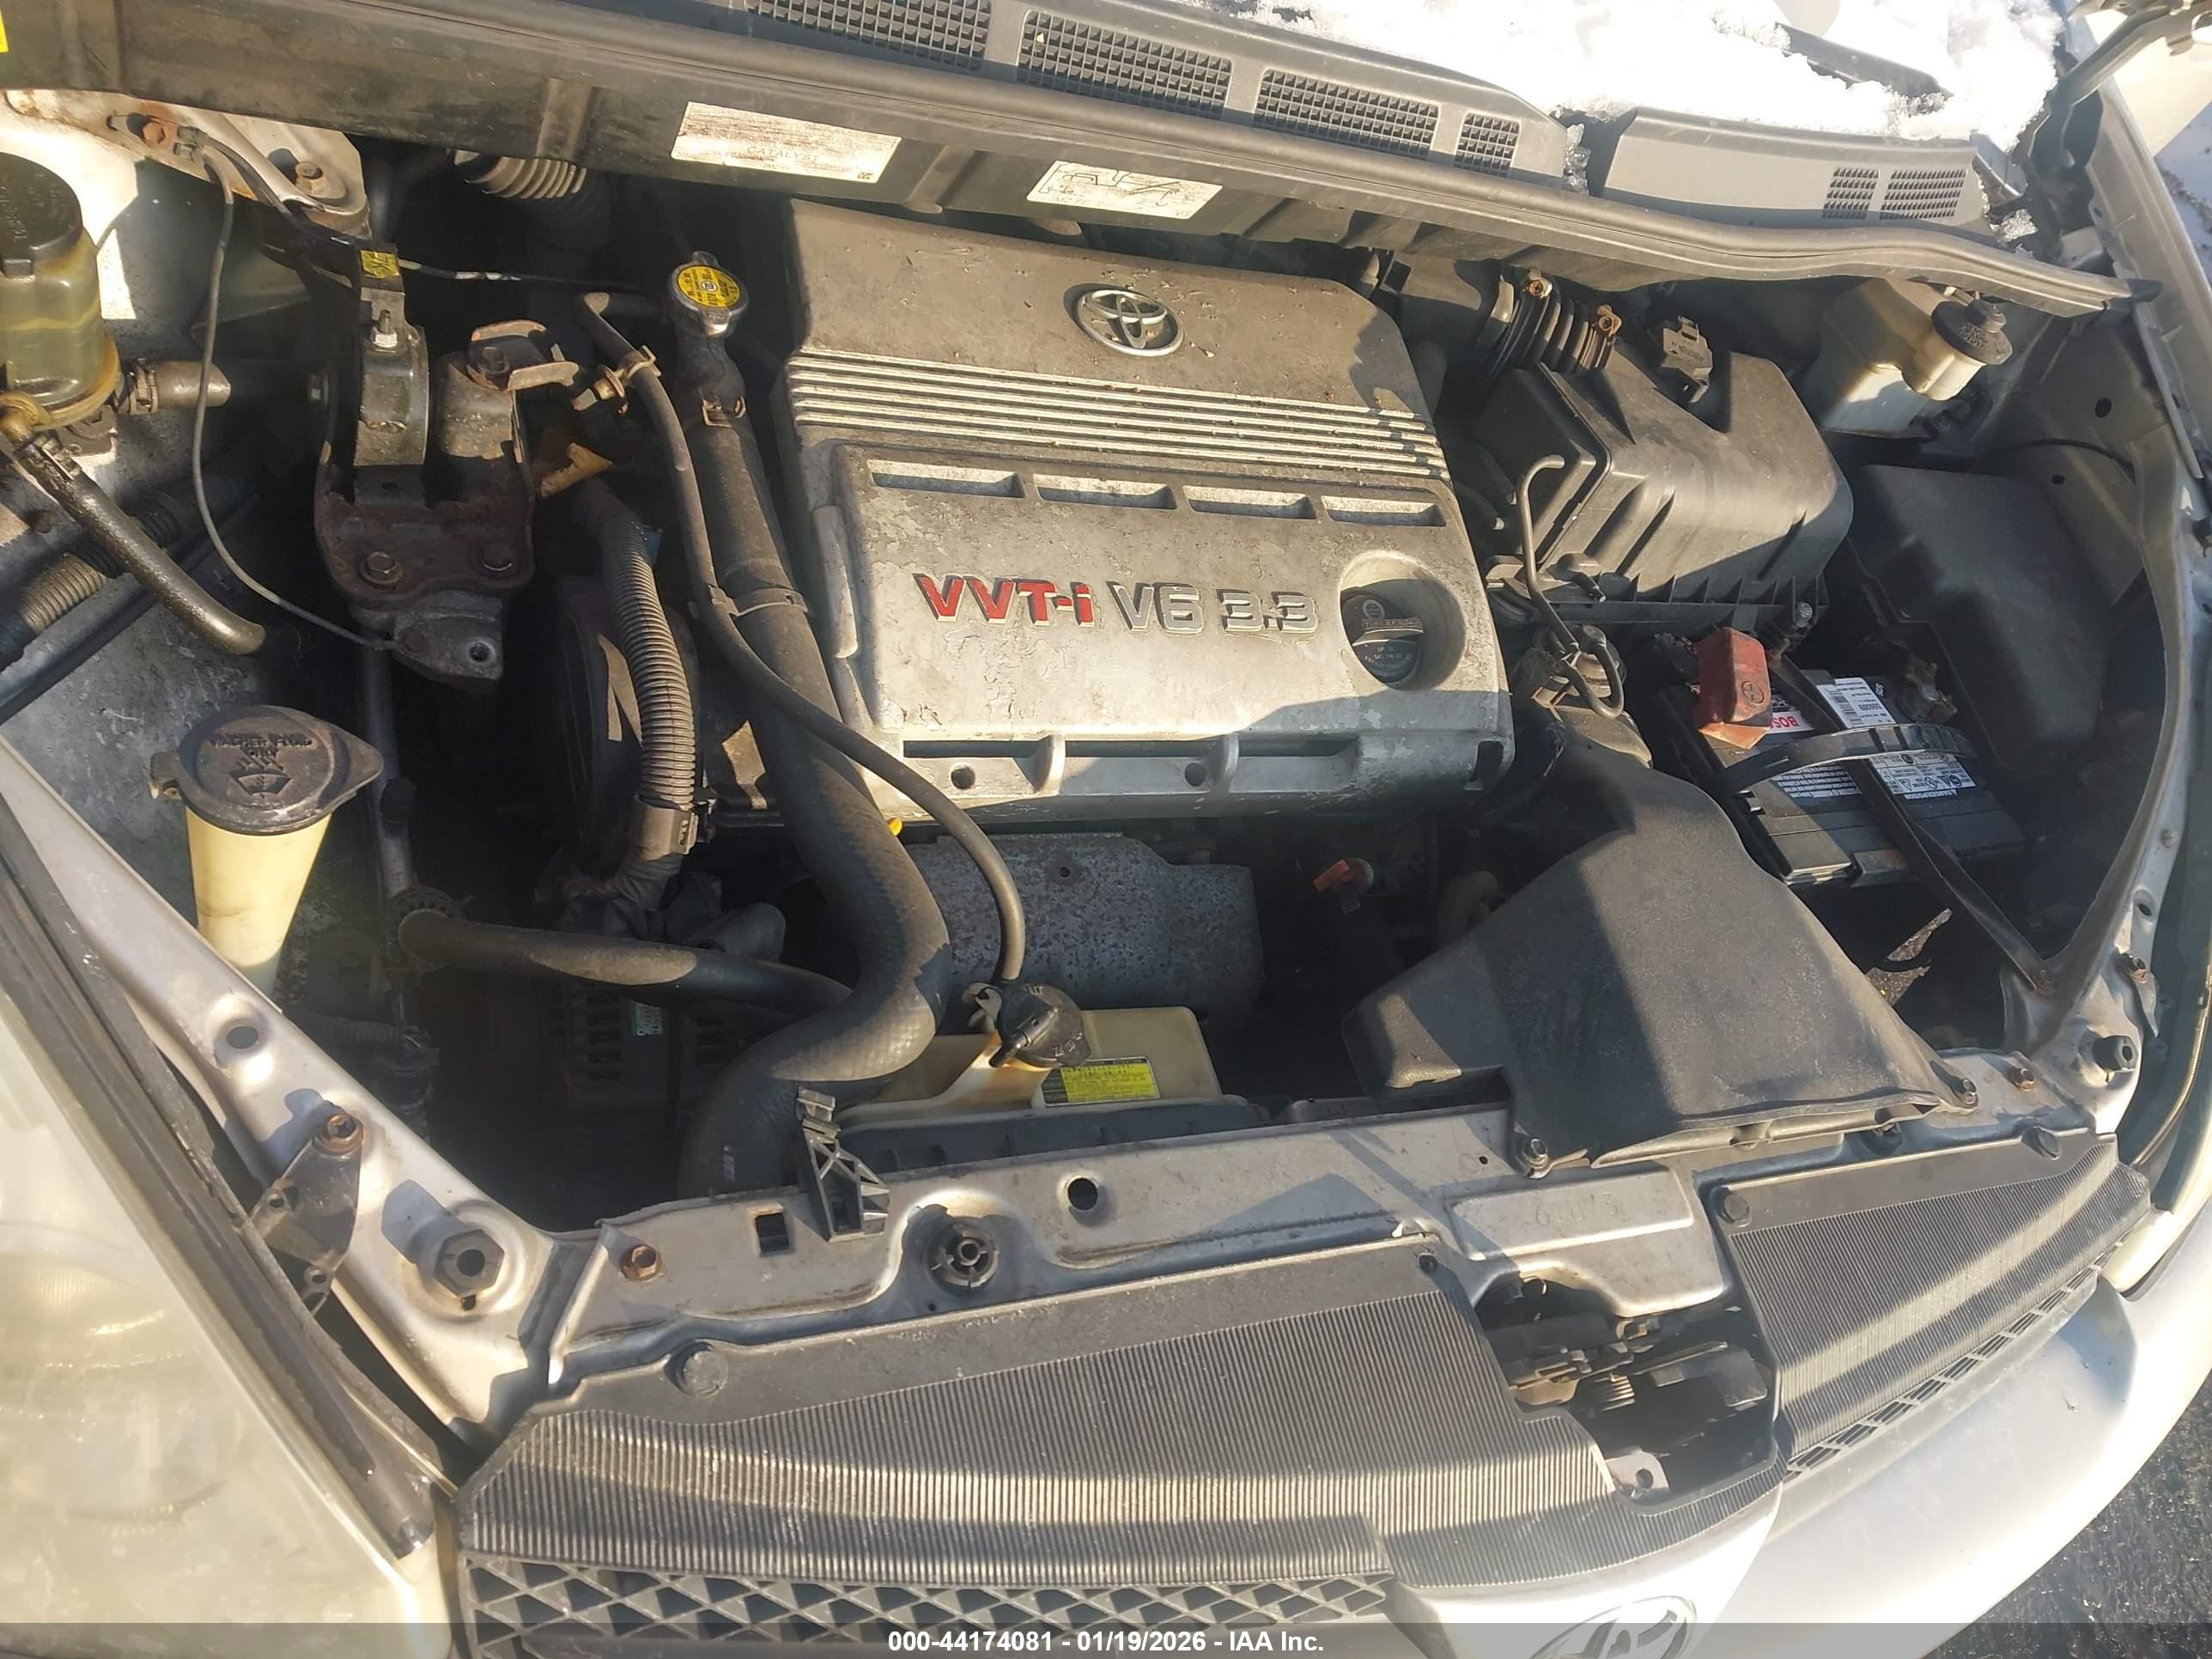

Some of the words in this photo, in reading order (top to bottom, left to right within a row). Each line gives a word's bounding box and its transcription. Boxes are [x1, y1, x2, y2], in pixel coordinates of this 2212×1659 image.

[914, 573, 1095, 628] VVT-i
[1110, 581, 1204, 634] V6
[1216, 589, 1319, 634] 3.3
